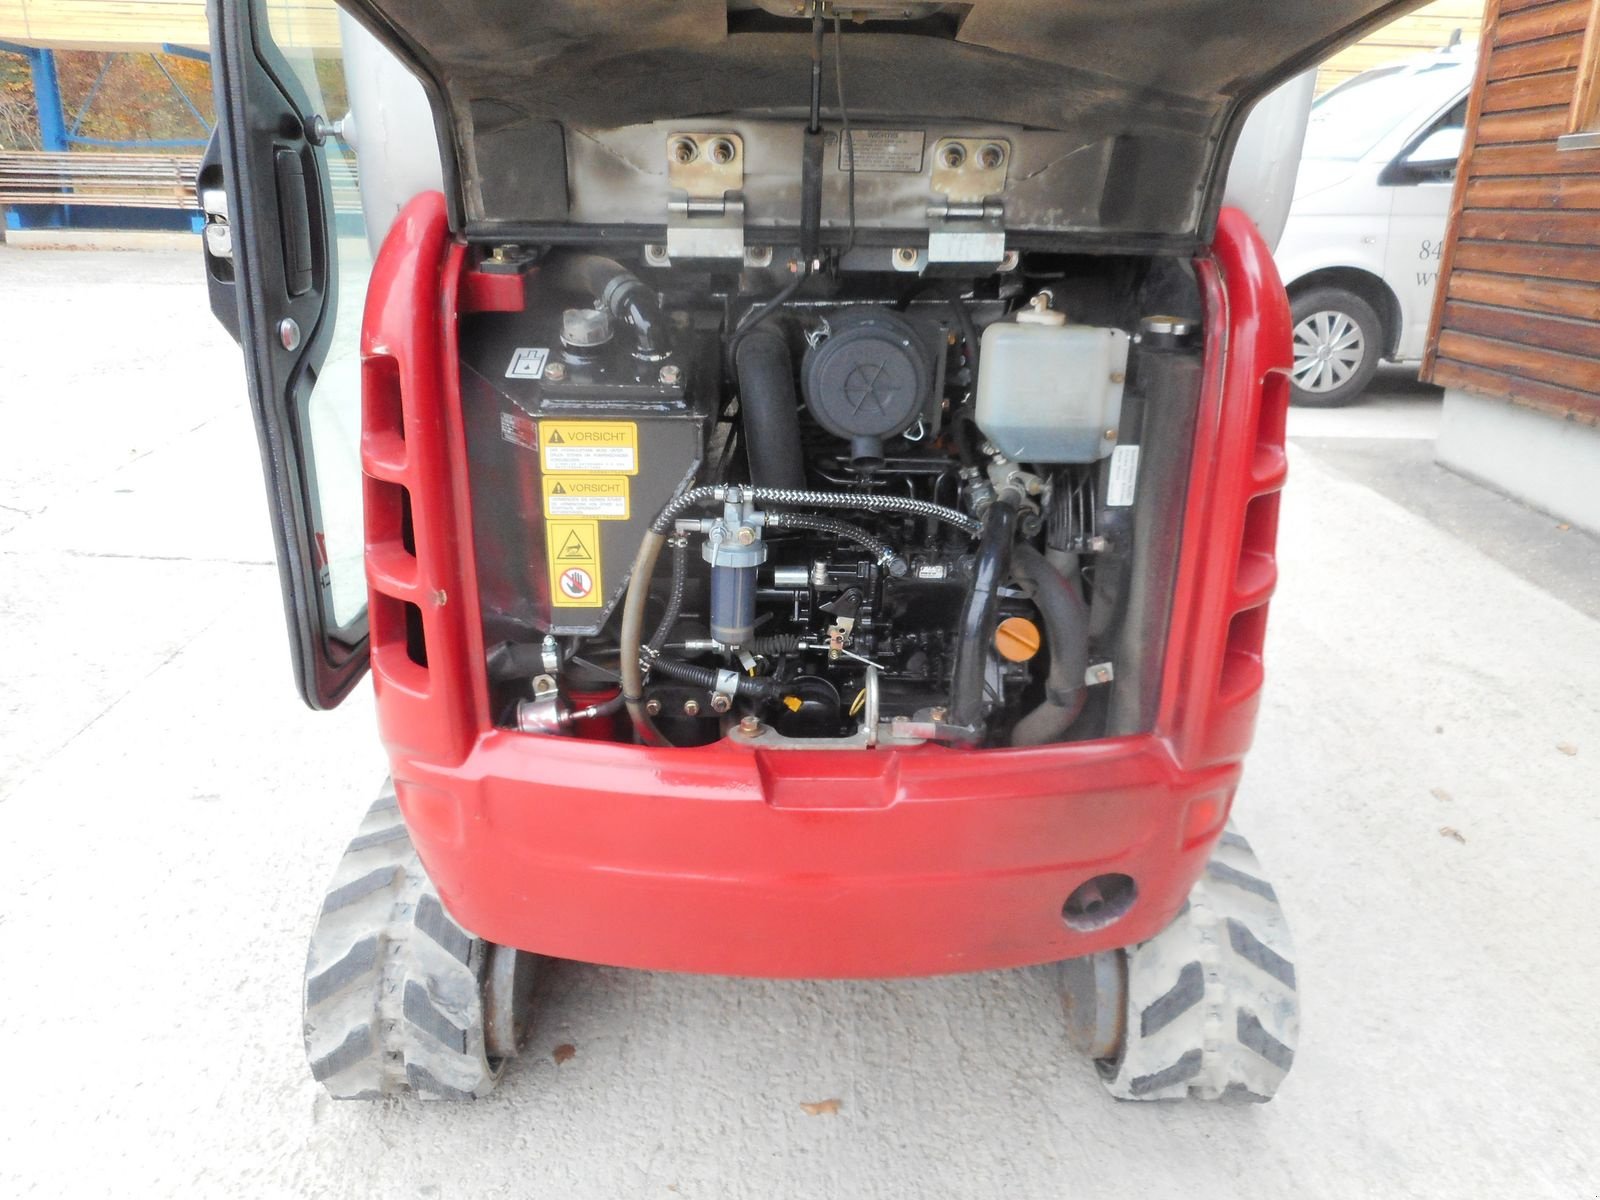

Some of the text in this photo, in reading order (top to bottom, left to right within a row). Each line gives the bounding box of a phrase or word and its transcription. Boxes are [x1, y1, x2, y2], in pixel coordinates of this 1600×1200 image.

[1419, 239, 1442, 260] 84
[568, 431, 626, 441] VORSICHT
[569, 483, 621, 492] VORSICHT
